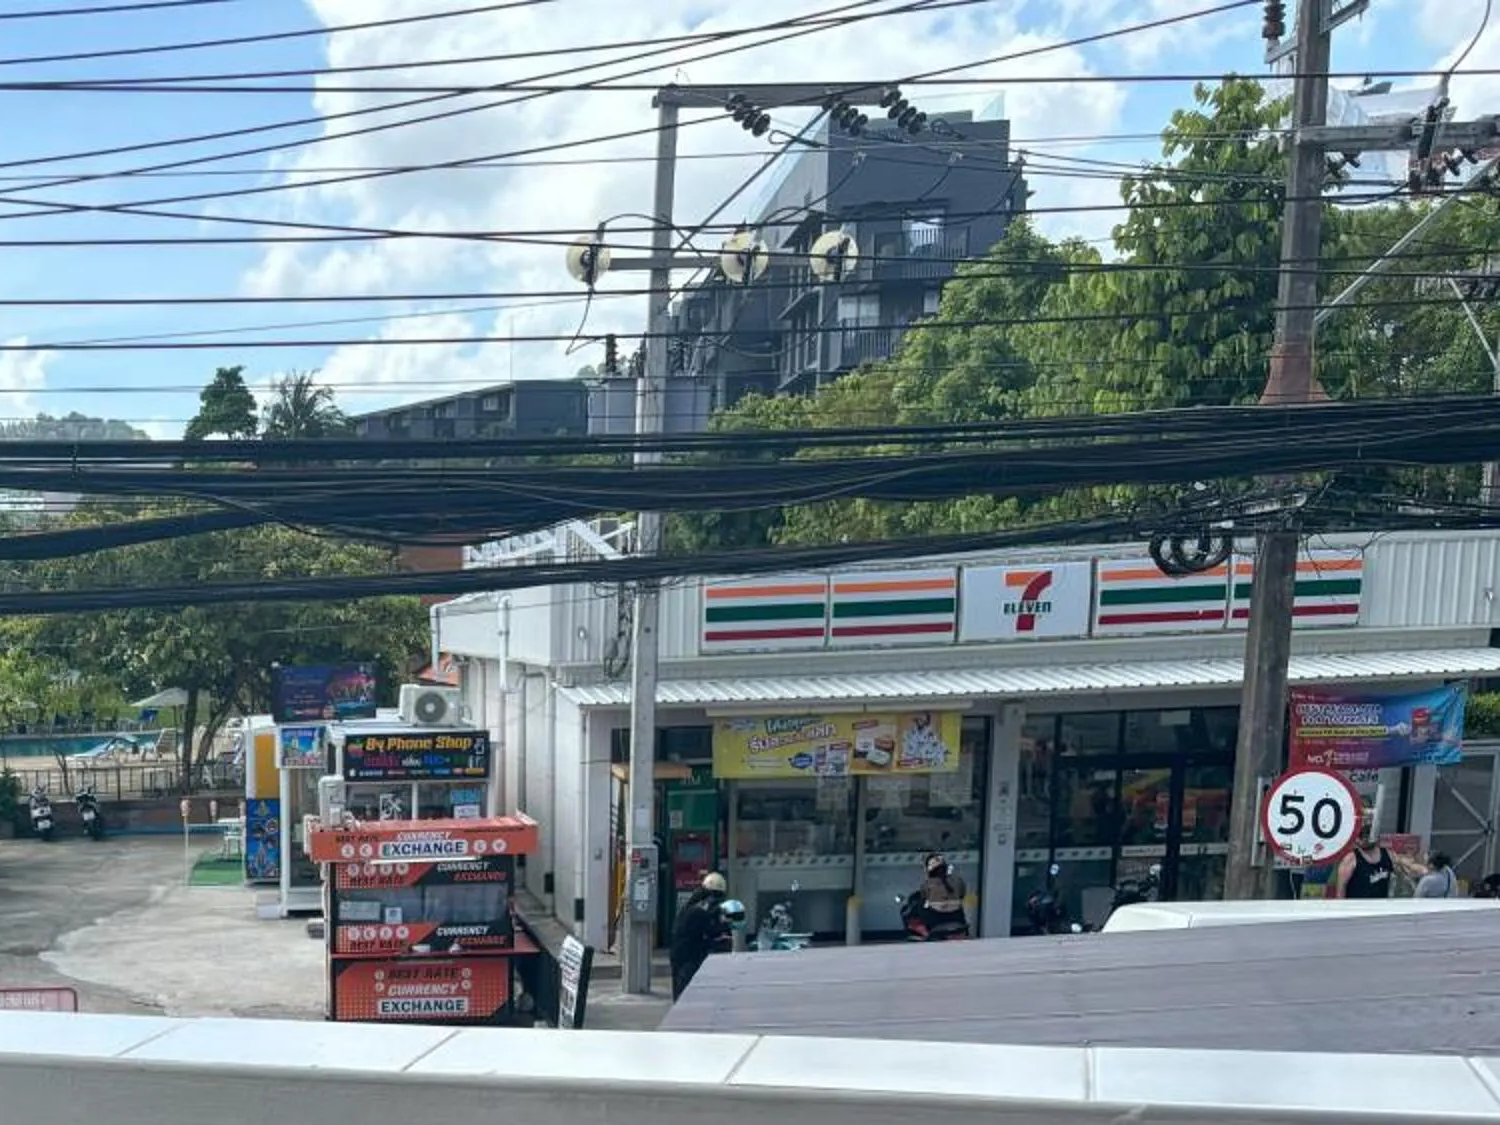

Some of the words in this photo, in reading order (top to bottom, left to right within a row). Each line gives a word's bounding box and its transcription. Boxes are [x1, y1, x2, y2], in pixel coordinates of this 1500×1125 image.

[1005, 570, 1052, 631] 7
[387, 736, 433, 750] Phone
[435, 735, 471, 750] Shop
[1278, 794, 1342, 839] 50
[382, 841, 465, 855] EXCHANGE
[388, 982, 459, 995] CURRENCY
[381, 999, 465, 1013] EXCHANGE
